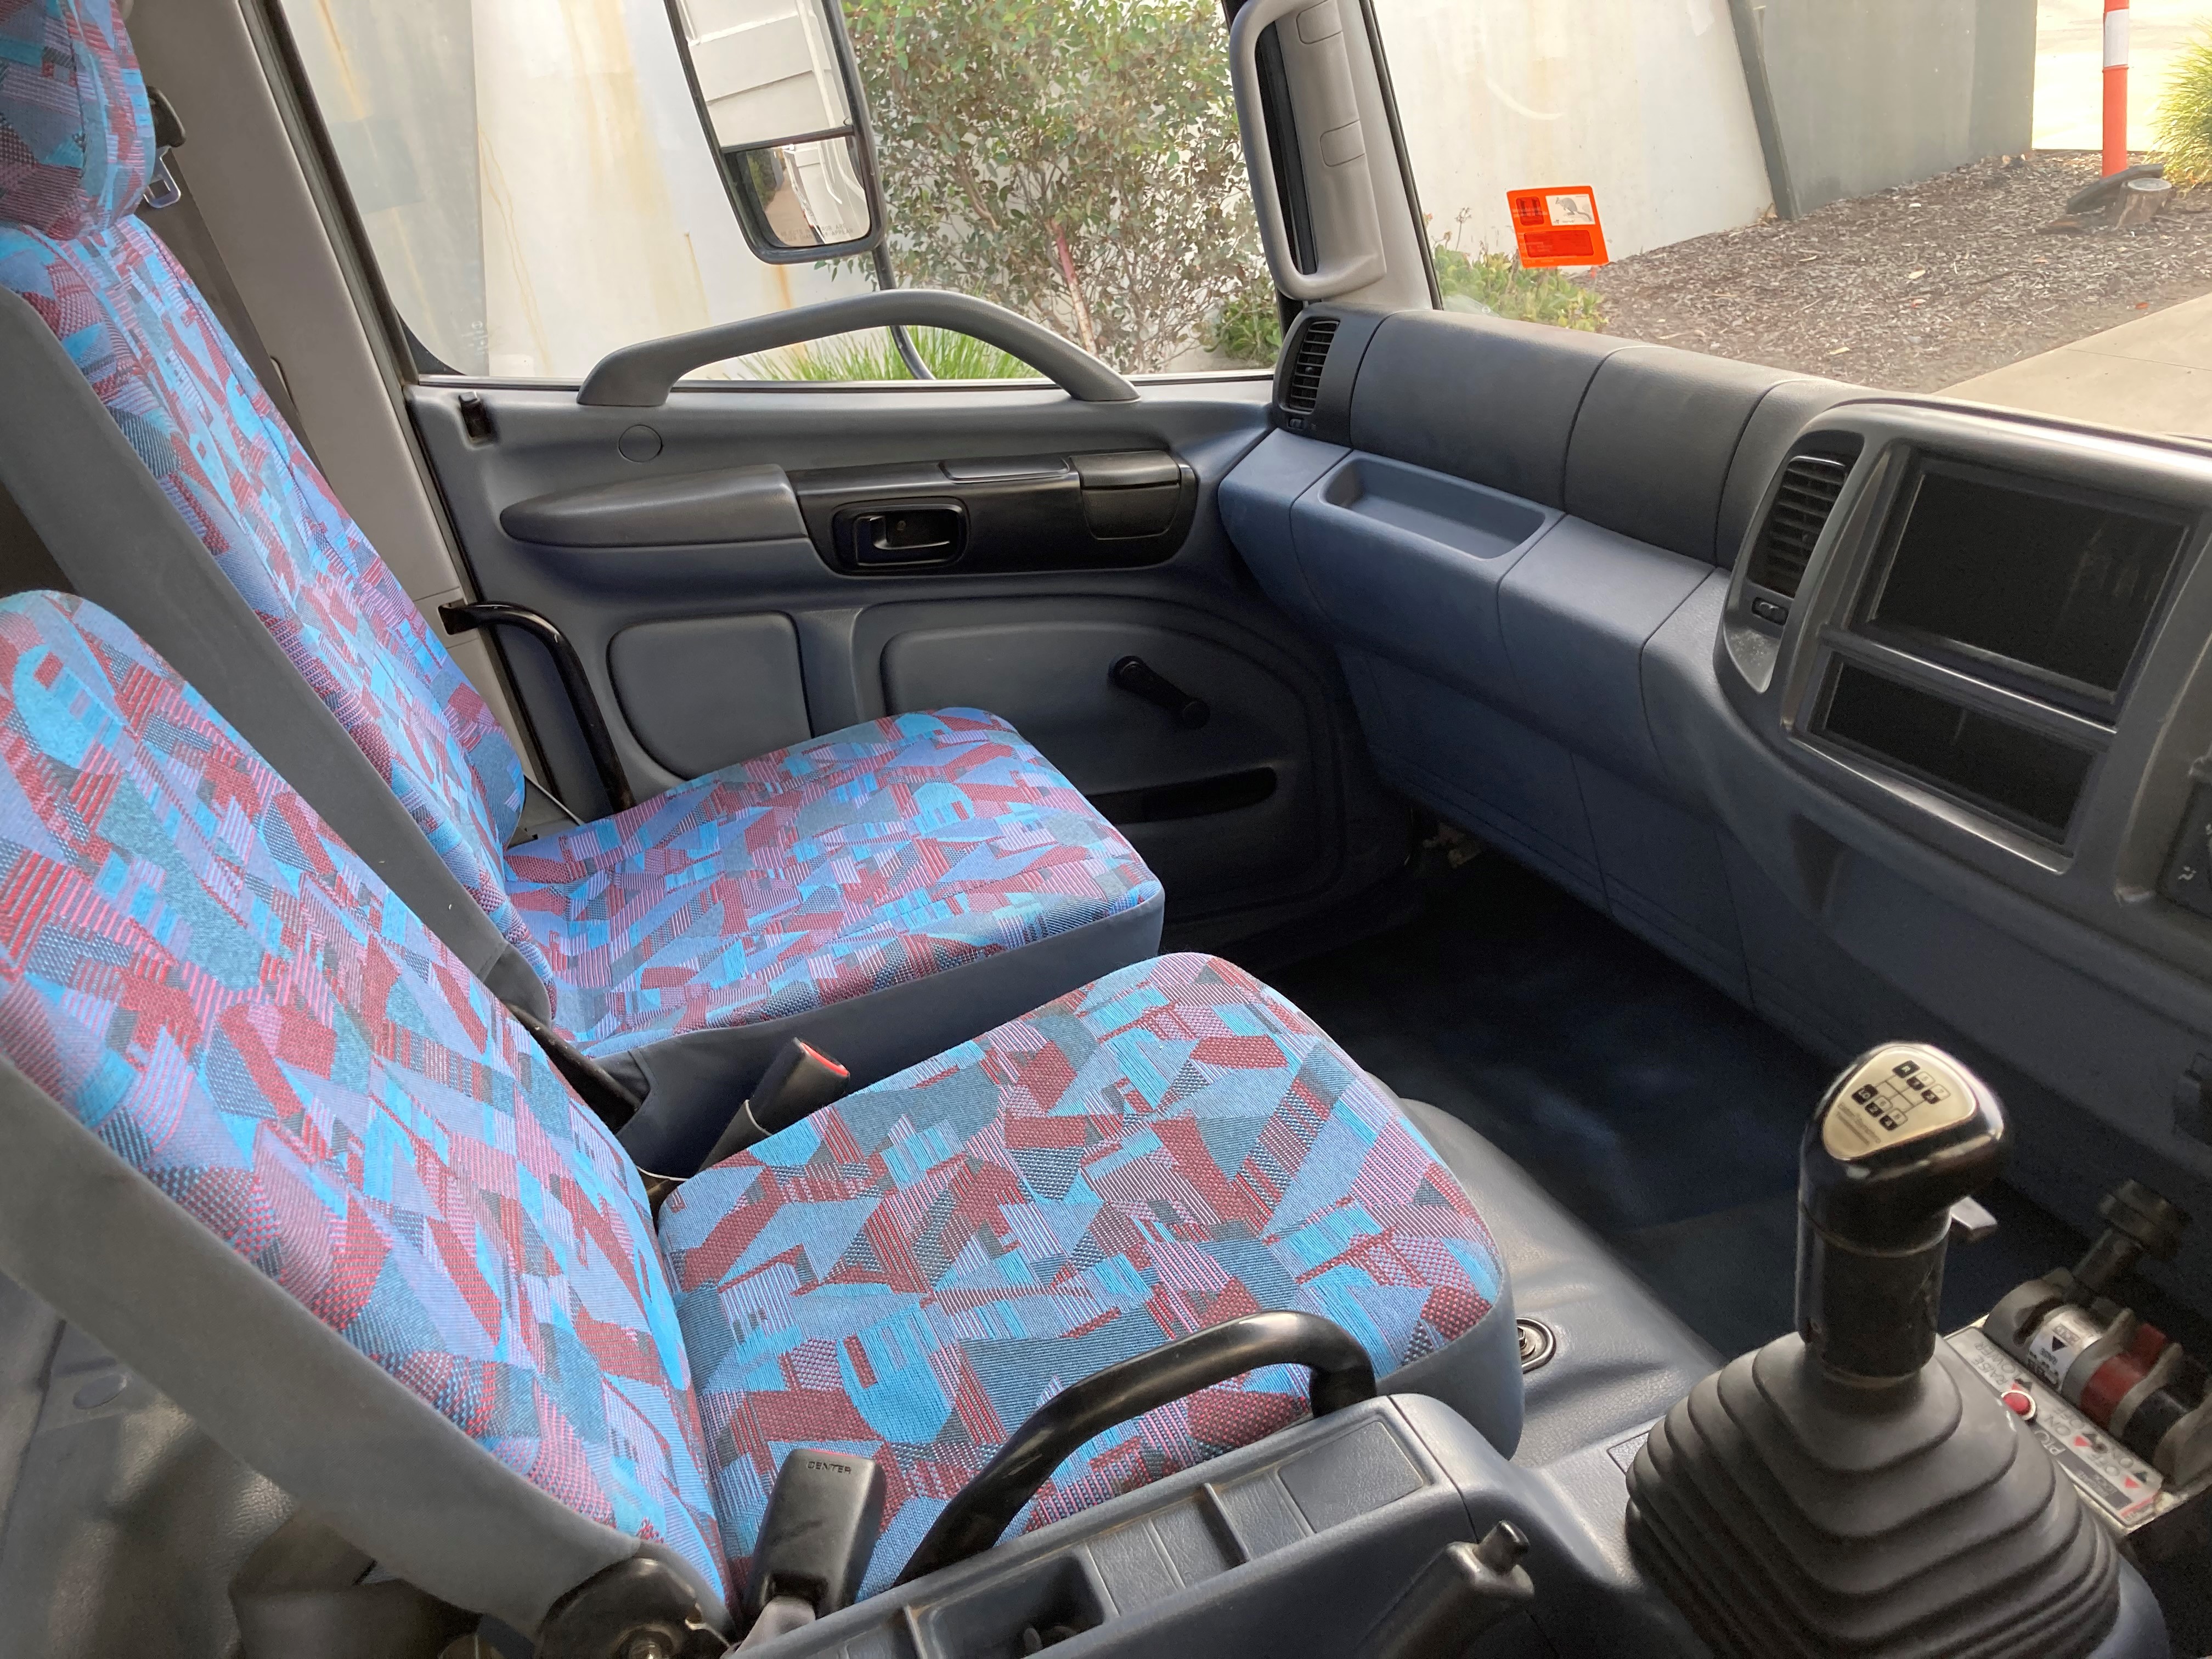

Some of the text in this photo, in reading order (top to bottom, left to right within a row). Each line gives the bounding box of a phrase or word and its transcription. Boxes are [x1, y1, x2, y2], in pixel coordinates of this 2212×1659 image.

[1971, 1355, 2008, 1385] RAISE
[2044, 1415, 2071, 1436] ON
[806, 1460, 852, 1475] CENTER
